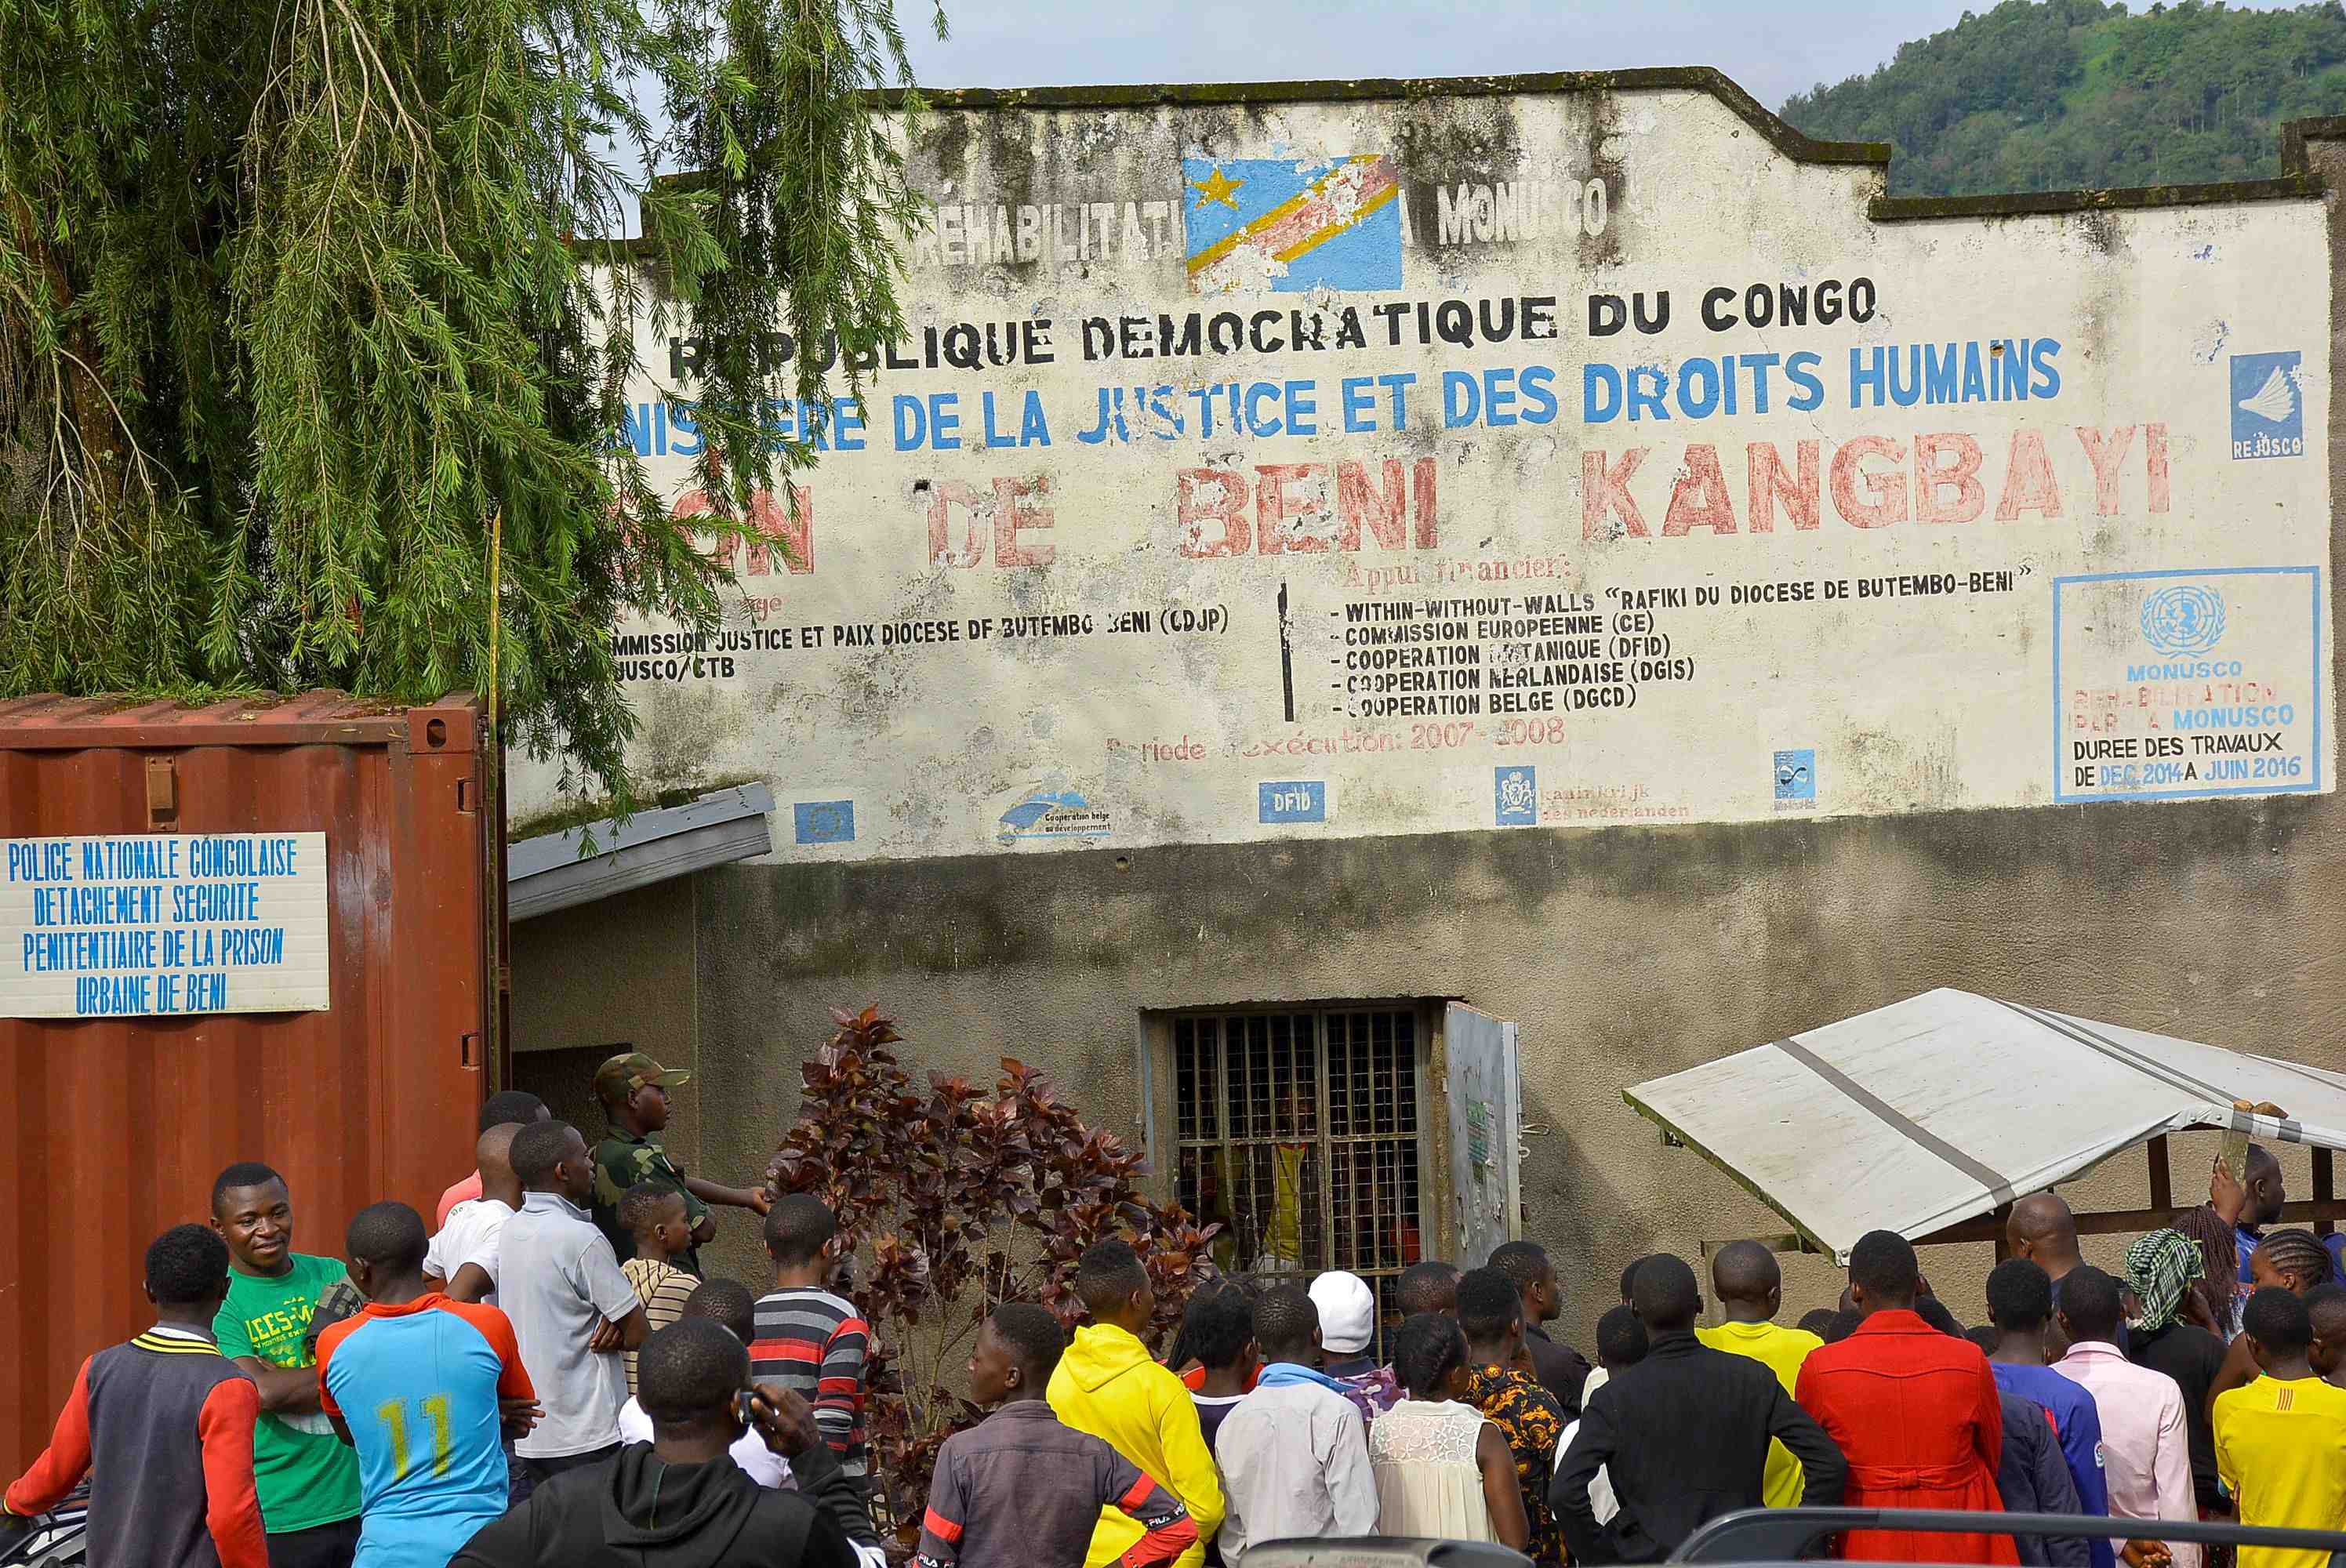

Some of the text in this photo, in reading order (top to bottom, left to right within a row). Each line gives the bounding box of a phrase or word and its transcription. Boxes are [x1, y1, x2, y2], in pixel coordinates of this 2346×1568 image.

[669, 277, 1876, 379] RPUBLIQUE DEMOCRATIQUE DU CONGO
[892, 392, 961, 452] DE
[982, 389, 1051, 448] LA
[1077, 379, 1317, 445] JUSTICE
[1341, 372, 1417, 434] ET
[1443, 365, 1559, 430] DES
[1583, 350, 1825, 424] DROITS
[1849, 336, 2062, 409] HUMAINS
[2233, 436, 2303, 459] REJUSCO
[928, 475, 1055, 570] DE
[1178, 456, 1439, 559] BENI
[1582, 421, 2170, 541] KANGBAYI
[1346, 593, 1595, 622] WITHIN-WITHOUT-WALLS
[1695, 586, 1720, 606] DU
[1730, 582, 1815, 604] DIOCESE
[1824, 579, 1850, 600] DE
[612, 632, 706, 656] MMISSION
[715, 628, 792, 652] JUSTICE
[801, 626, 824, 648] ET
[833, 623, 874, 647] PAIX
[881, 619, 960, 646] DIOCESE
[1160, 604, 1230, 637] (CDJP)
[1477, 615, 1603, 640] EUROPEENNE
[1611, 610, 1654, 635] (CE)
[614, 656, 735, 683] JUSCO/CTB
[1346, 644, 1480, 670] COOPERATION
[1609, 633, 1671, 659] (DFID)
[1347, 657, 1696, 694] COOPERATION NERLANDAISE (DGIS)
[2126, 661, 2243, 684] MONUSCO
[1489, 690, 1554, 713] BELGE
[1563, 683, 1637, 711] (DGCD)
[2173, 703, 2294, 731] MONUSCO
[2074, 731, 2283, 760] DUREE DES TRAVAUX
[2075, 765, 2095, 787] DE
[2184, 761, 2199, 781] A
[2204, 759, 2249, 781] JUIN
[2253, 755, 2302, 779] 2016
[1273, 789, 1311, 812] DFID
[9, 838, 297, 881] POLICE NATIONALE CONGOLAISE
[34, 882, 260, 926] DETACHEMENT SECURITE
[24, 927, 285, 972] PENITENTIAIRE DE LA PRISON
[76, 972, 226, 1016] URBAINE DE BENI
[377, 1393, 452, 1483] 11
[918, 1552, 939, 1568] FILA
